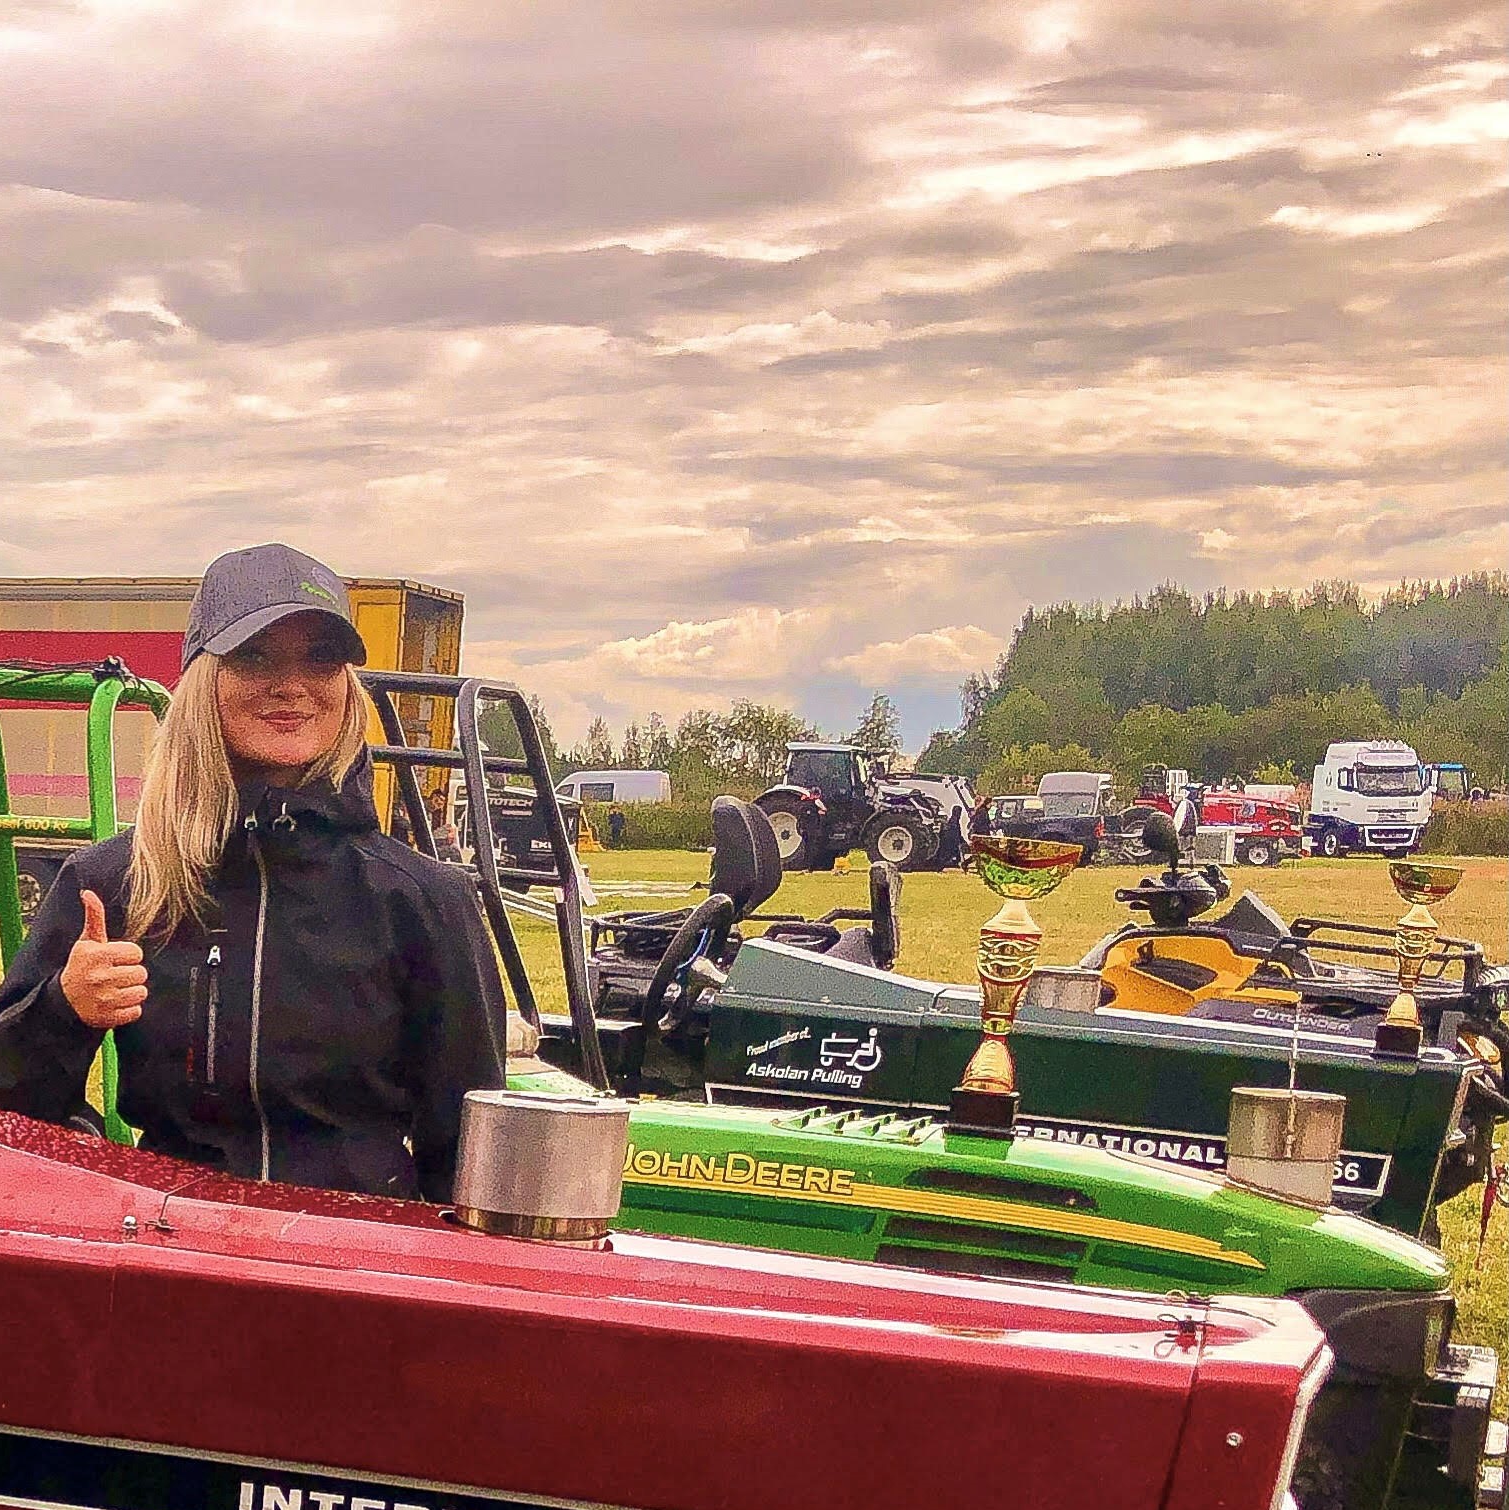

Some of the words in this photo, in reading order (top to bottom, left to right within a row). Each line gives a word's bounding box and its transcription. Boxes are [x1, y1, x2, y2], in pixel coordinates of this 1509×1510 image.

[489, 797, 533, 807] TOTECH
[811, 1068, 863, 1089] Pulling
[623, 1143, 716, 1180] JOHN
[724, 1152, 856, 1196] DEERE
[1010, 1125, 1225, 1165] ERNATIONAL
[1332, 1160, 1360, 1181] 66
